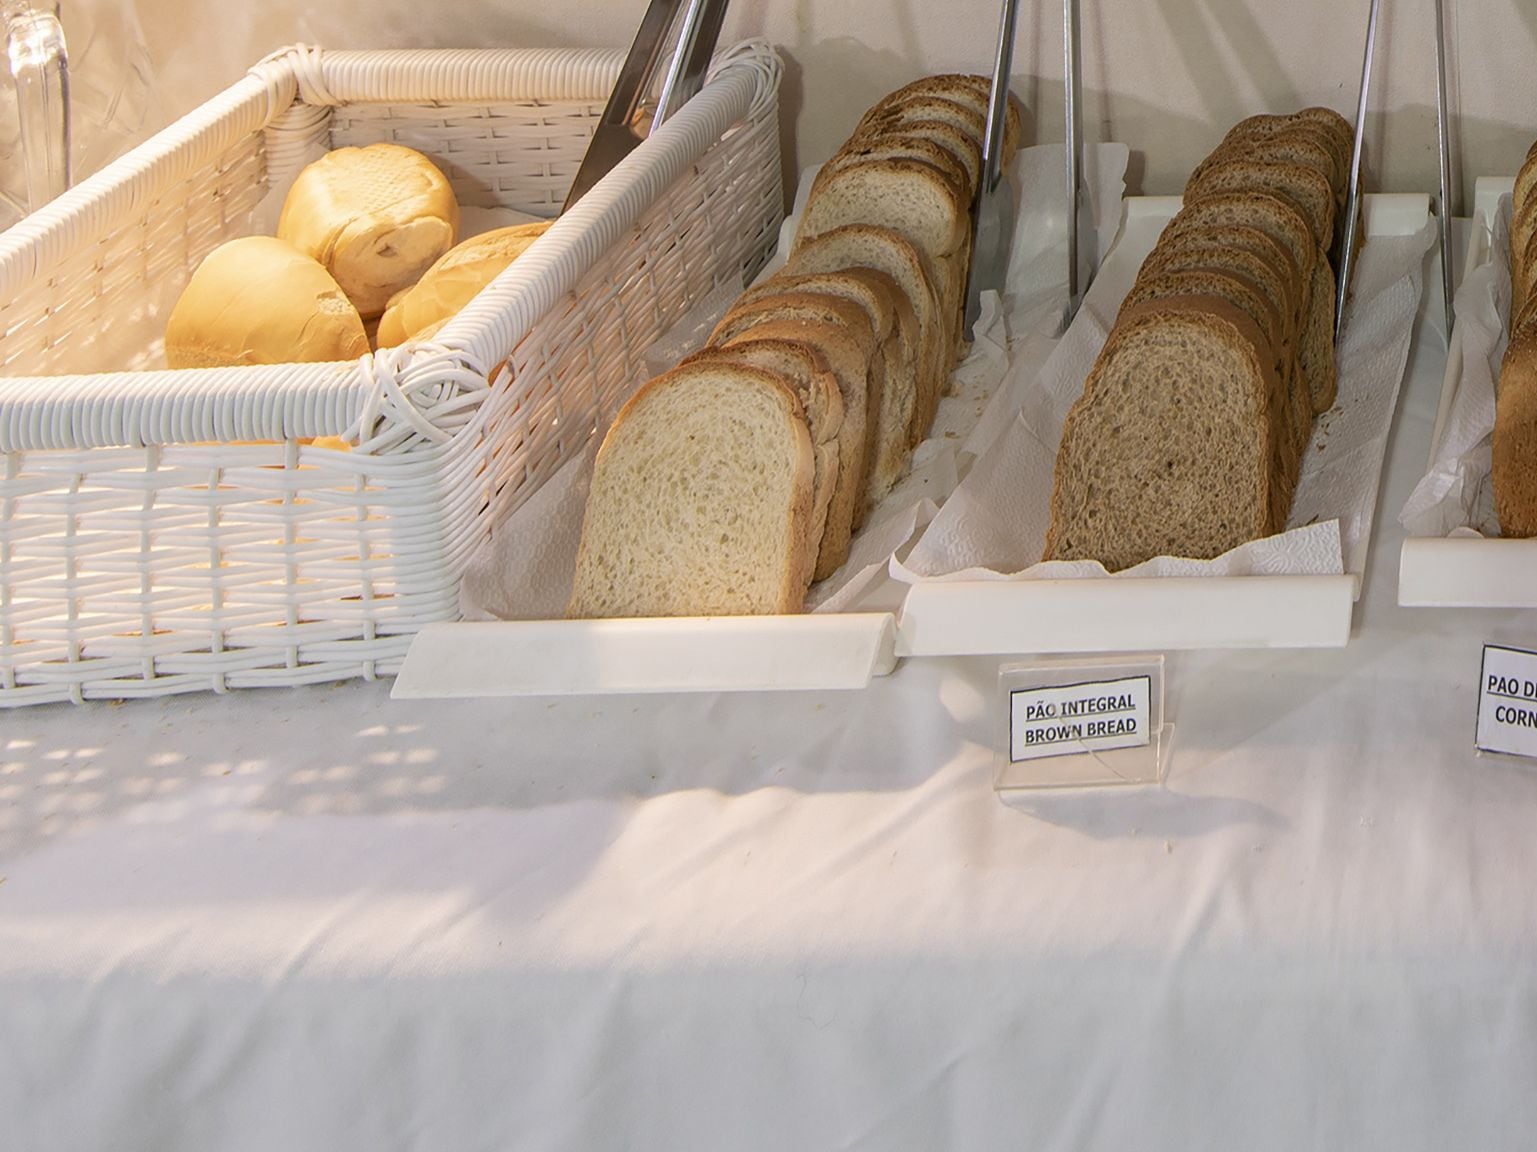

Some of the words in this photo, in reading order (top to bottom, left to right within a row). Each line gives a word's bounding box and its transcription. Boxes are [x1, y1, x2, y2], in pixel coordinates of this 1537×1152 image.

[1488, 675, 1519, 695] PAO
[1026, 700, 1056, 719] PÃO
[1061, 694, 1136, 715] INTEGRAL
[1025, 724, 1082, 744] BROWN
[1087, 718, 1137, 736] BREAD
